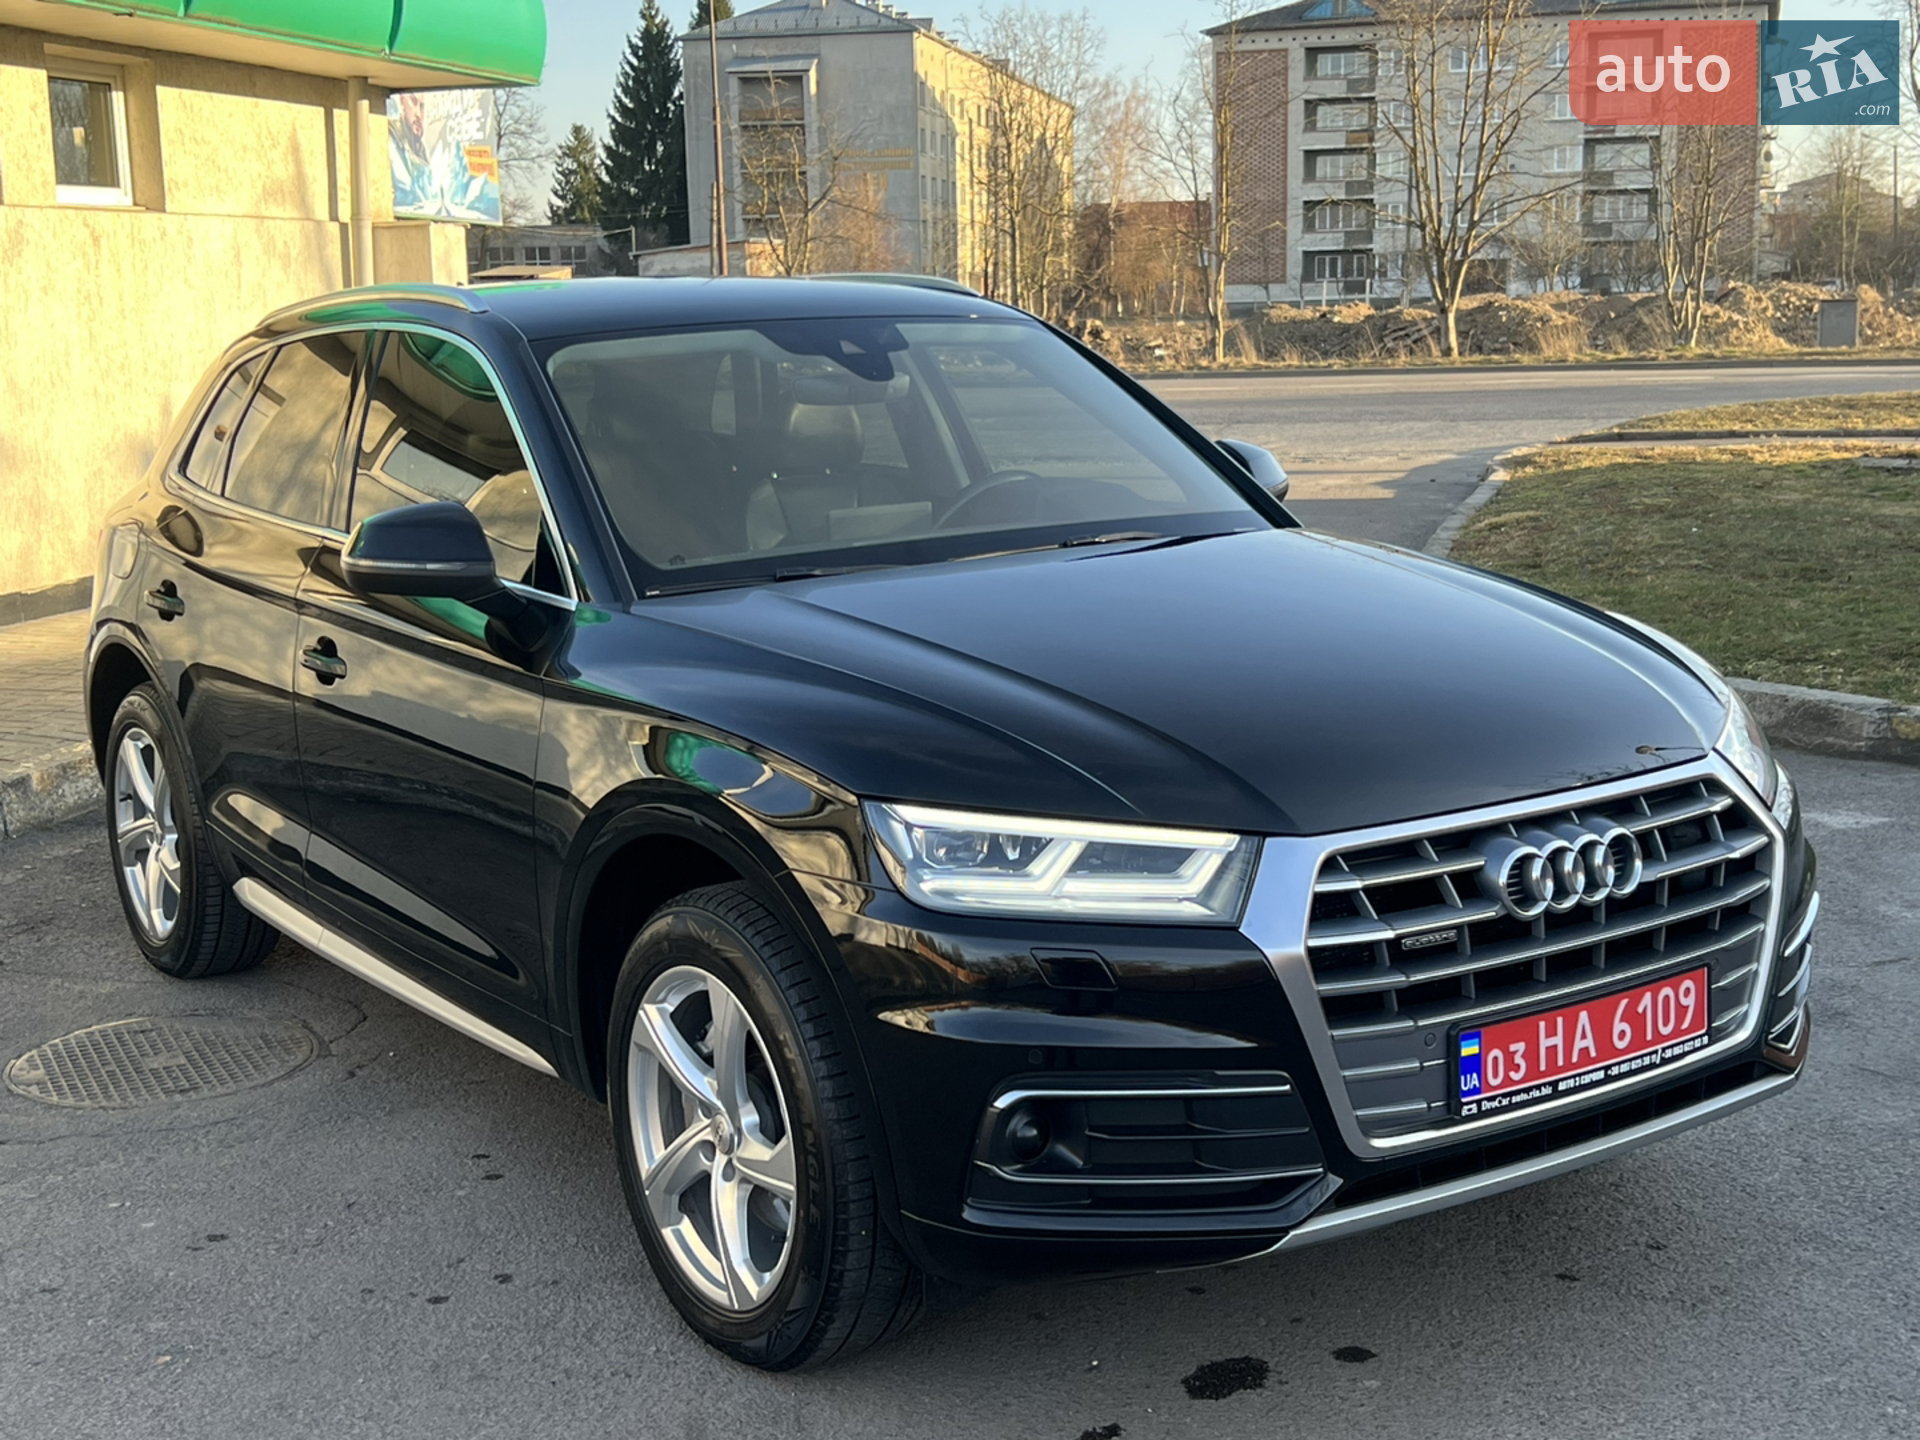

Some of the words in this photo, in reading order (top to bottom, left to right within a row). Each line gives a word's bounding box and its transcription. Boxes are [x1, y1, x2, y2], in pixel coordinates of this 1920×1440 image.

[1486, 1041, 1527, 1087] 03
[1612, 979, 1697, 1050] 6109
[1461, 1072, 1480, 1091] UA
